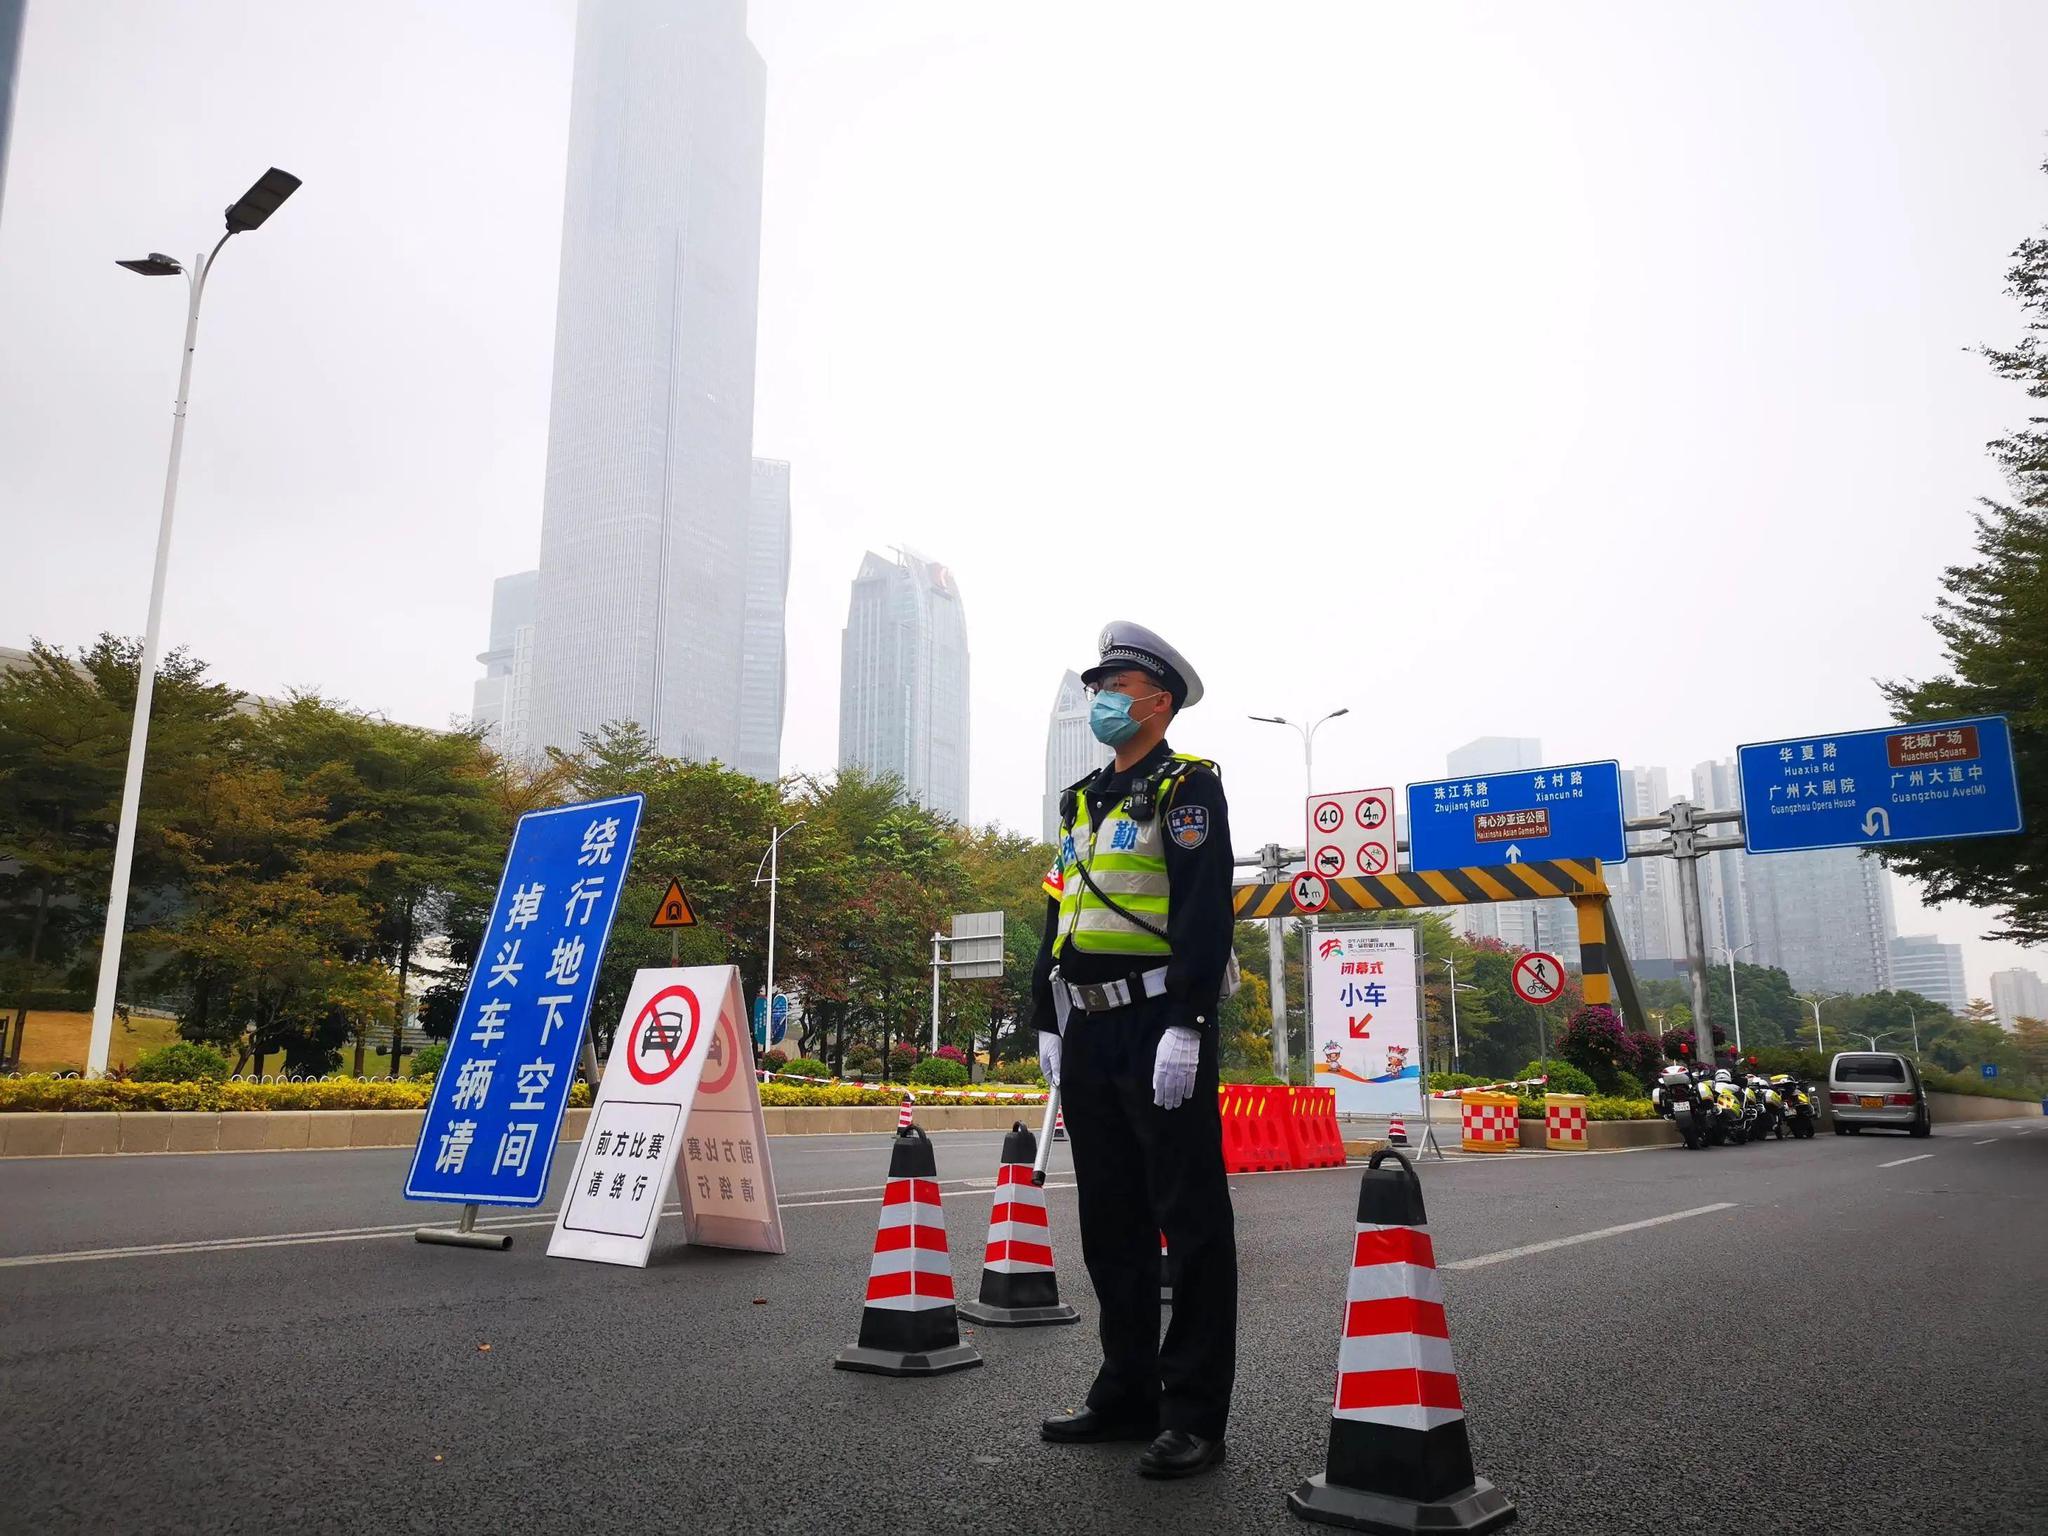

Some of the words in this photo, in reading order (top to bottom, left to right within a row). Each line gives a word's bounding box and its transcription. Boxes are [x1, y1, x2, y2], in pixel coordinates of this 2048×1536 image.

[1901, 730, 1963, 750] 花城广场
[1779, 742, 1837, 763] 华夏路
[1901, 750, 1938, 762] Huacheng
[1940, 747, 1967, 760] Square
[1784, 764, 1820, 776] Huaxia
[1822, 762, 1835, 772] Rd
[1891, 764, 1983, 789] 广州大道中
[1434, 781, 1488, 800] 珠江东路
[1535, 791, 1570, 802] Xiancun
[1572, 789, 1583, 798] Rd
[1769, 777, 1856, 801] 广州大剧院
[1892, 789, 1949, 803] Guangzhou
[1952, 785, 1986, 798] Ave(M)
[1434, 802, 1469, 813] Zhujiang
[1771, 802, 1811, 815] Guangzhou
[1811, 800, 1833, 812] Opera
[1834, 799, 1856, 809] House
[1320, 810, 1338, 824] 40
[1478, 810, 1545, 829] 海心沙亚运公园
[1503, 828, 1518, 837] Asian
[1518, 826, 1535, 835] Games
[1536, 825, 1548, 834] Park
[1340, 961, 1384, 975] 闭幕式
[492, 817, 620, 1177] 绕行地下空间
[1340, 982, 1387, 1008] 小车
[435, 882, 546, 1175] 掉头车辆请
[594, 1130, 665, 1160] 前方比赛
[587, 1171, 648, 1202] 请绕行
